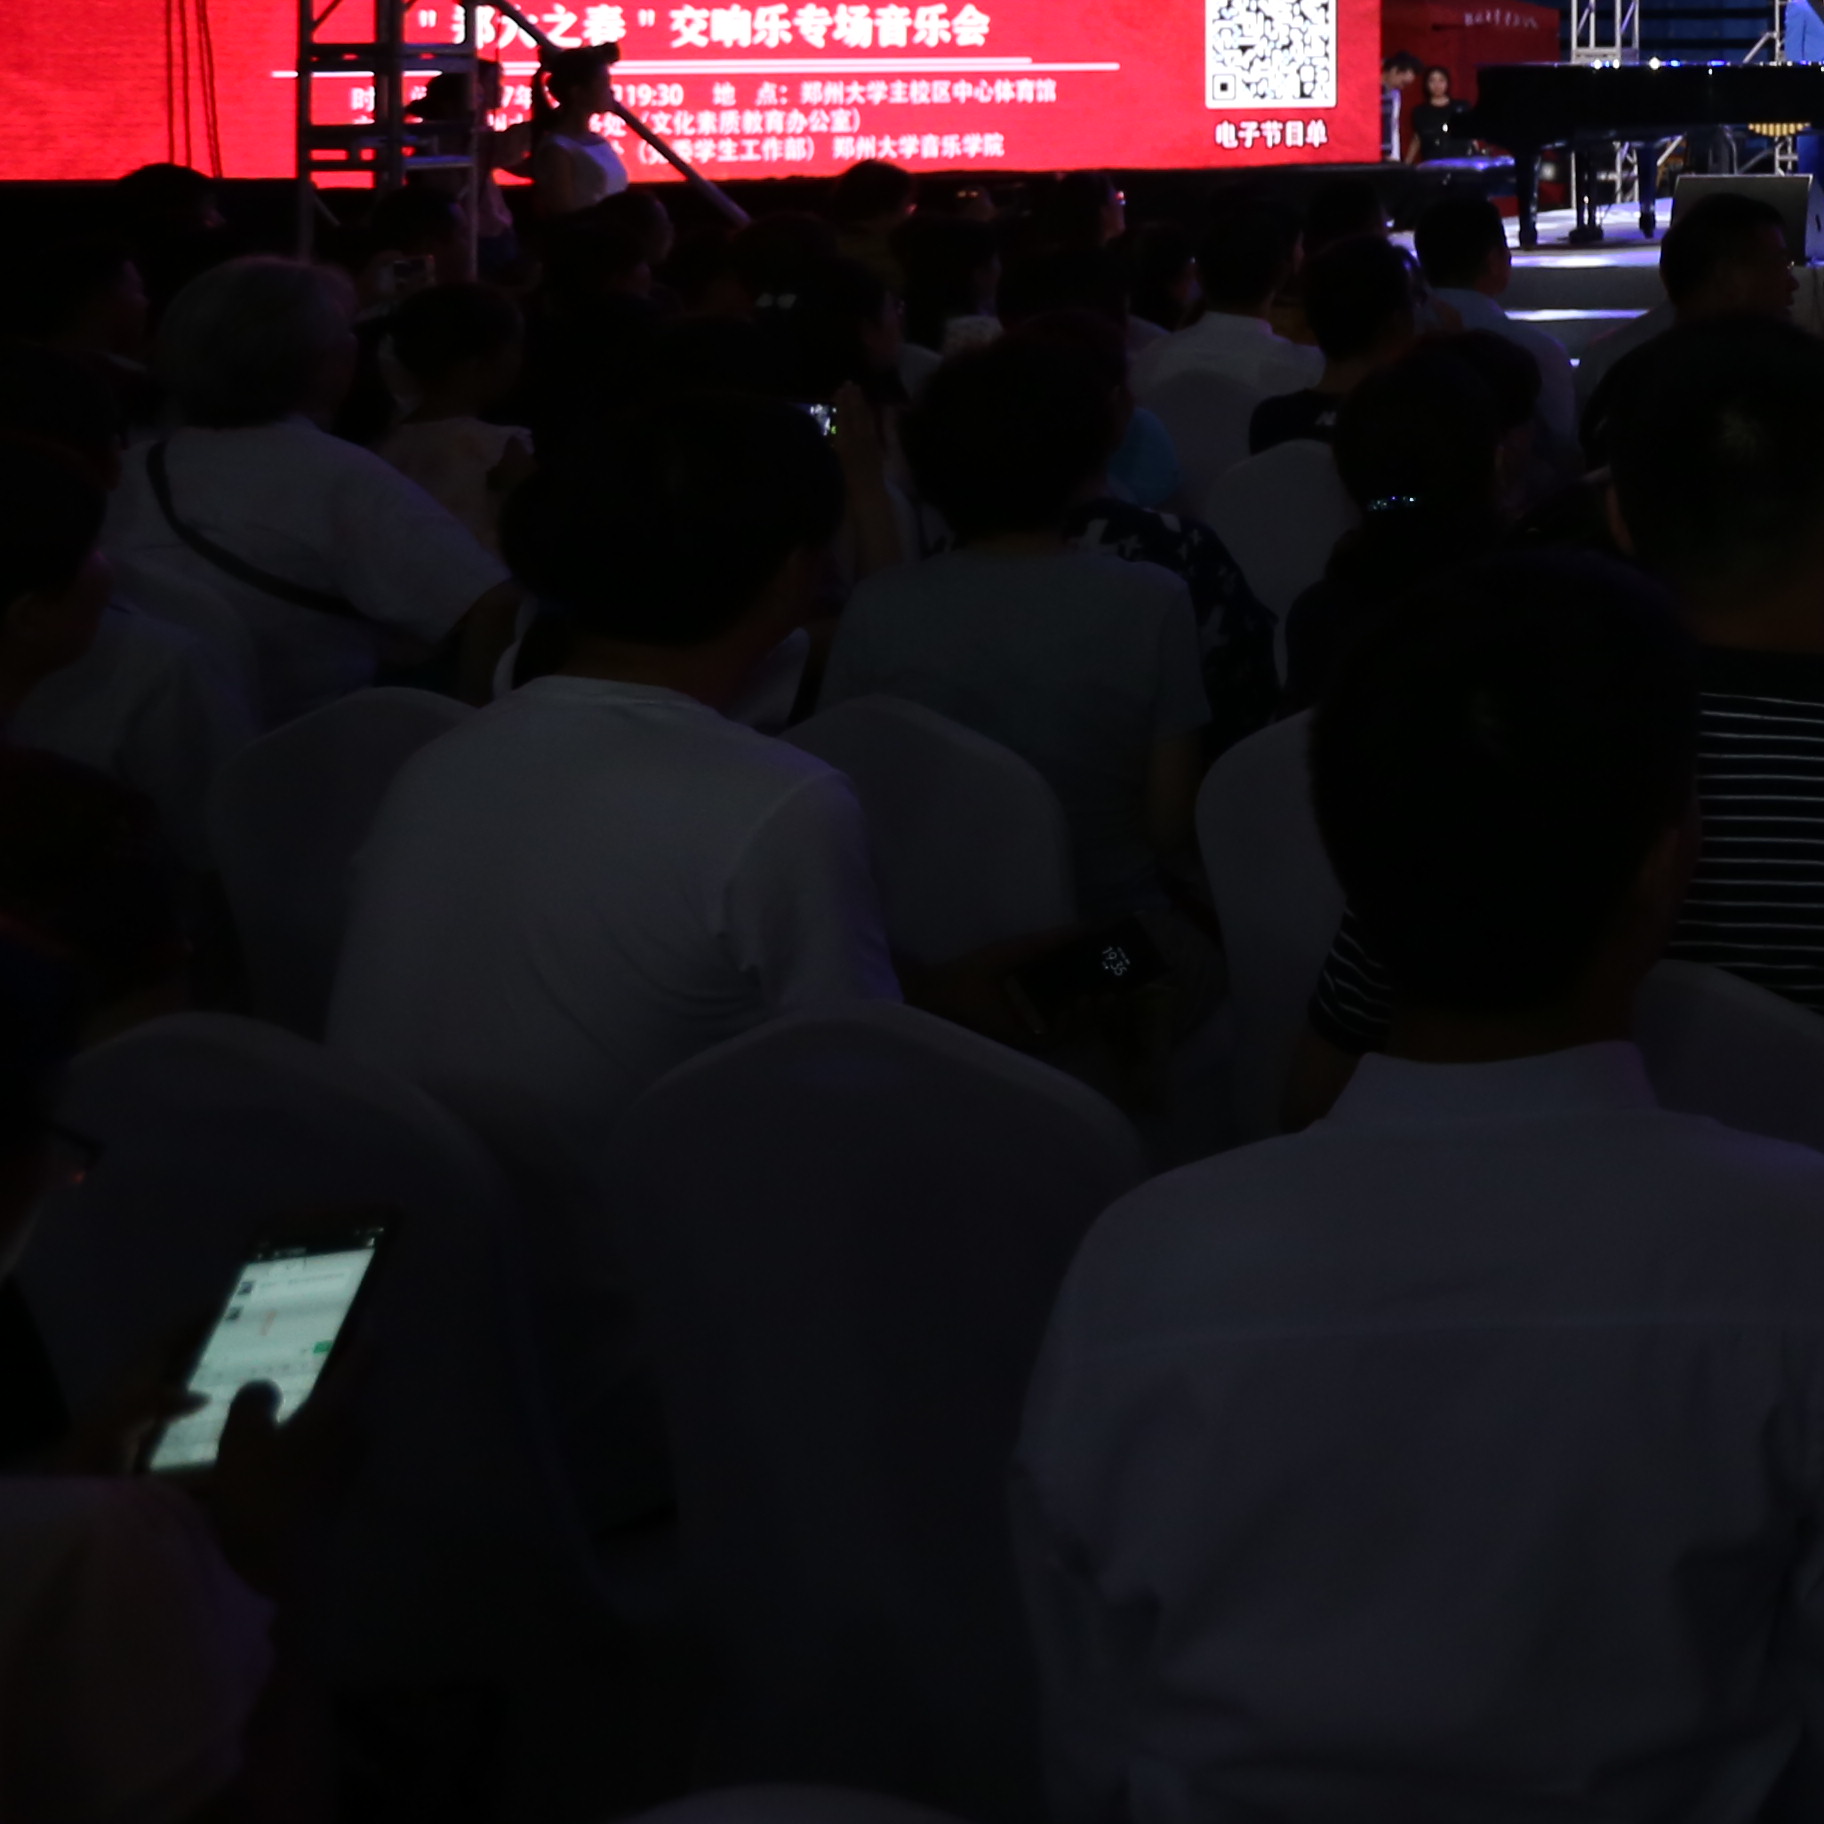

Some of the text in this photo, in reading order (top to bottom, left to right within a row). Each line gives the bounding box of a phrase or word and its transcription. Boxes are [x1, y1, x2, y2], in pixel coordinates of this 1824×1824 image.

[1214, 119, 1329, 149] 电子节目单
